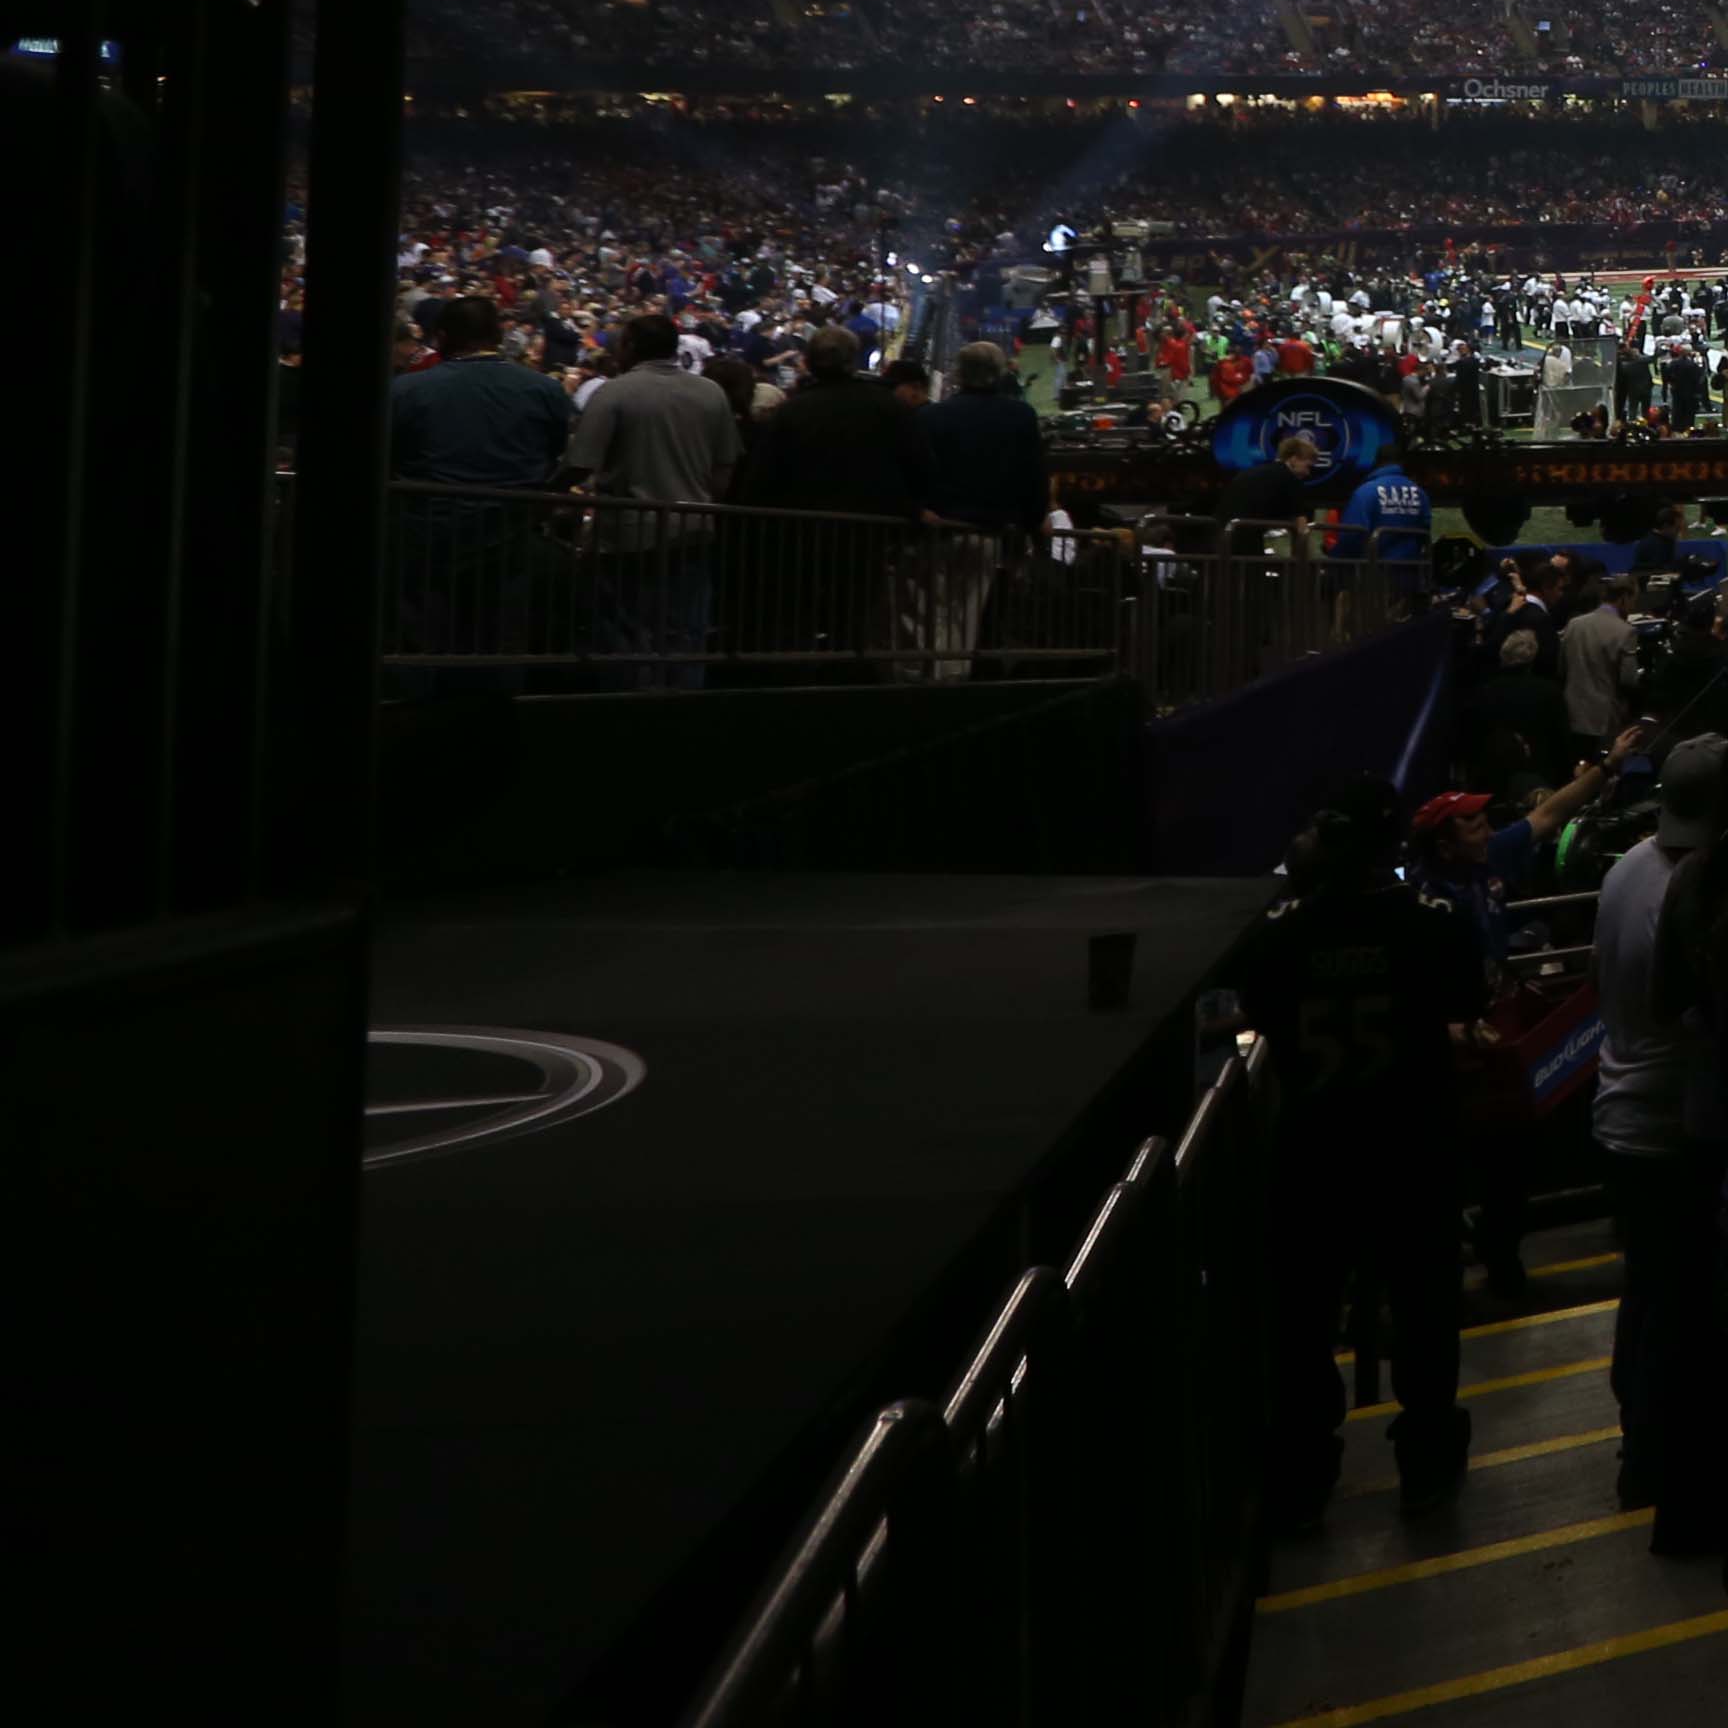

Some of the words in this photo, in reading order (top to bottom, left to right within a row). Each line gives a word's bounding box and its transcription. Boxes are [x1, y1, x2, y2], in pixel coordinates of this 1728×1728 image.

[1463, 79, 1549, 98] Ochsner
[1622, 81, 1676, 97] PEOPLES
[1680, 81, 1726, 97] HEALTH
[1277, 410, 1333, 429] NFL
[1297, 994, 1392, 1090] 55
